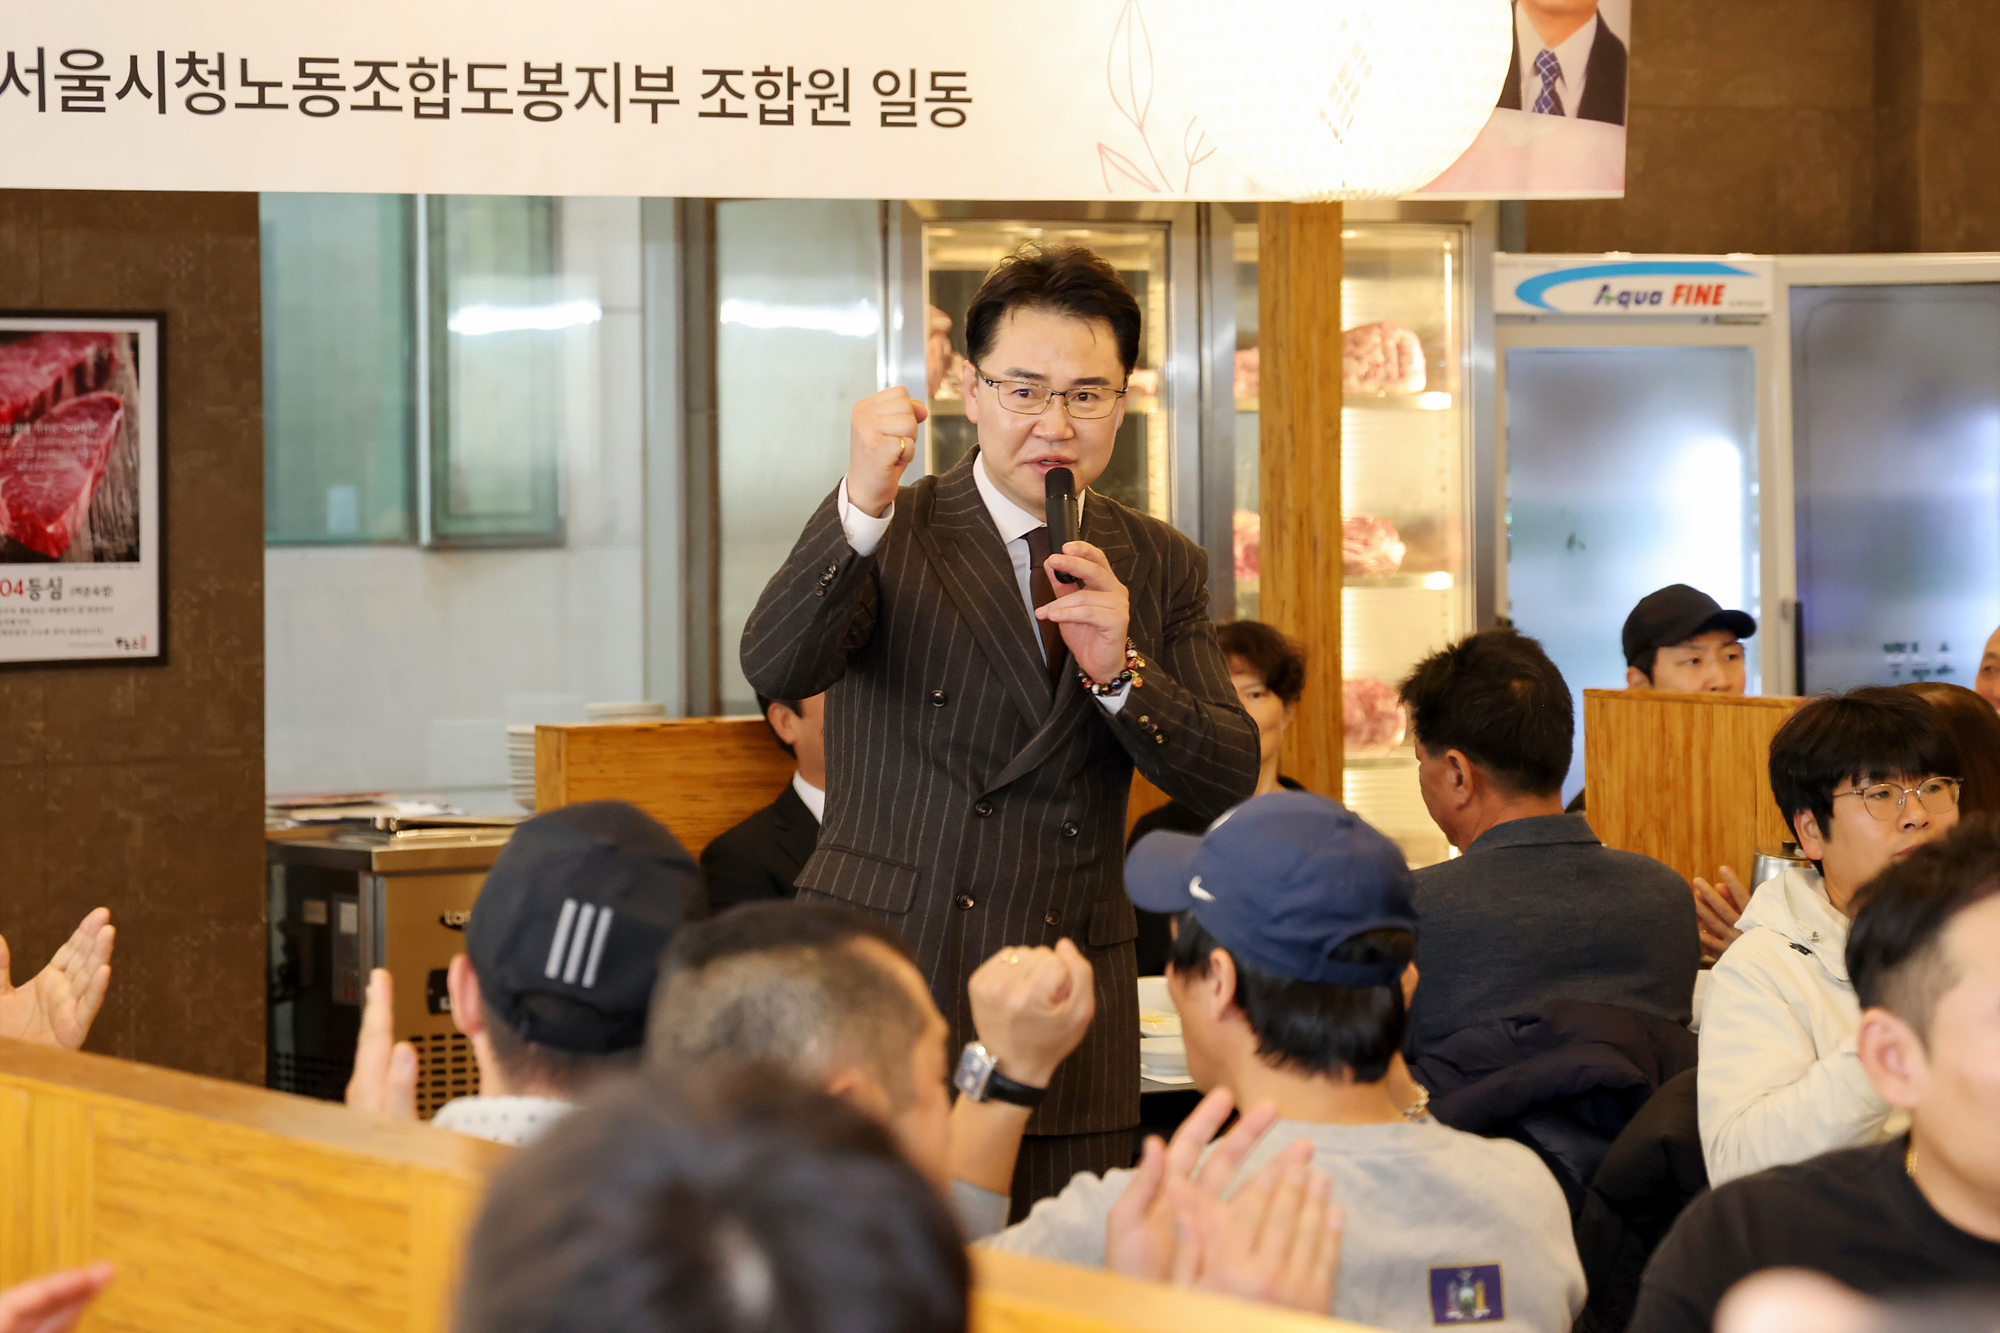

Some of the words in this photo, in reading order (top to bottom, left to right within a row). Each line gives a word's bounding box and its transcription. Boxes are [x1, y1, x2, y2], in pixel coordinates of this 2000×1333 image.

[0, 47, 679, 123] 서울시청노동조합도봉지부
[699, 66, 850, 126] 조합원
[873, 69, 971, 127] 일동
[1594, 283, 1664, 311] Aqua
[1671, 284, 1726, 307] FINE
